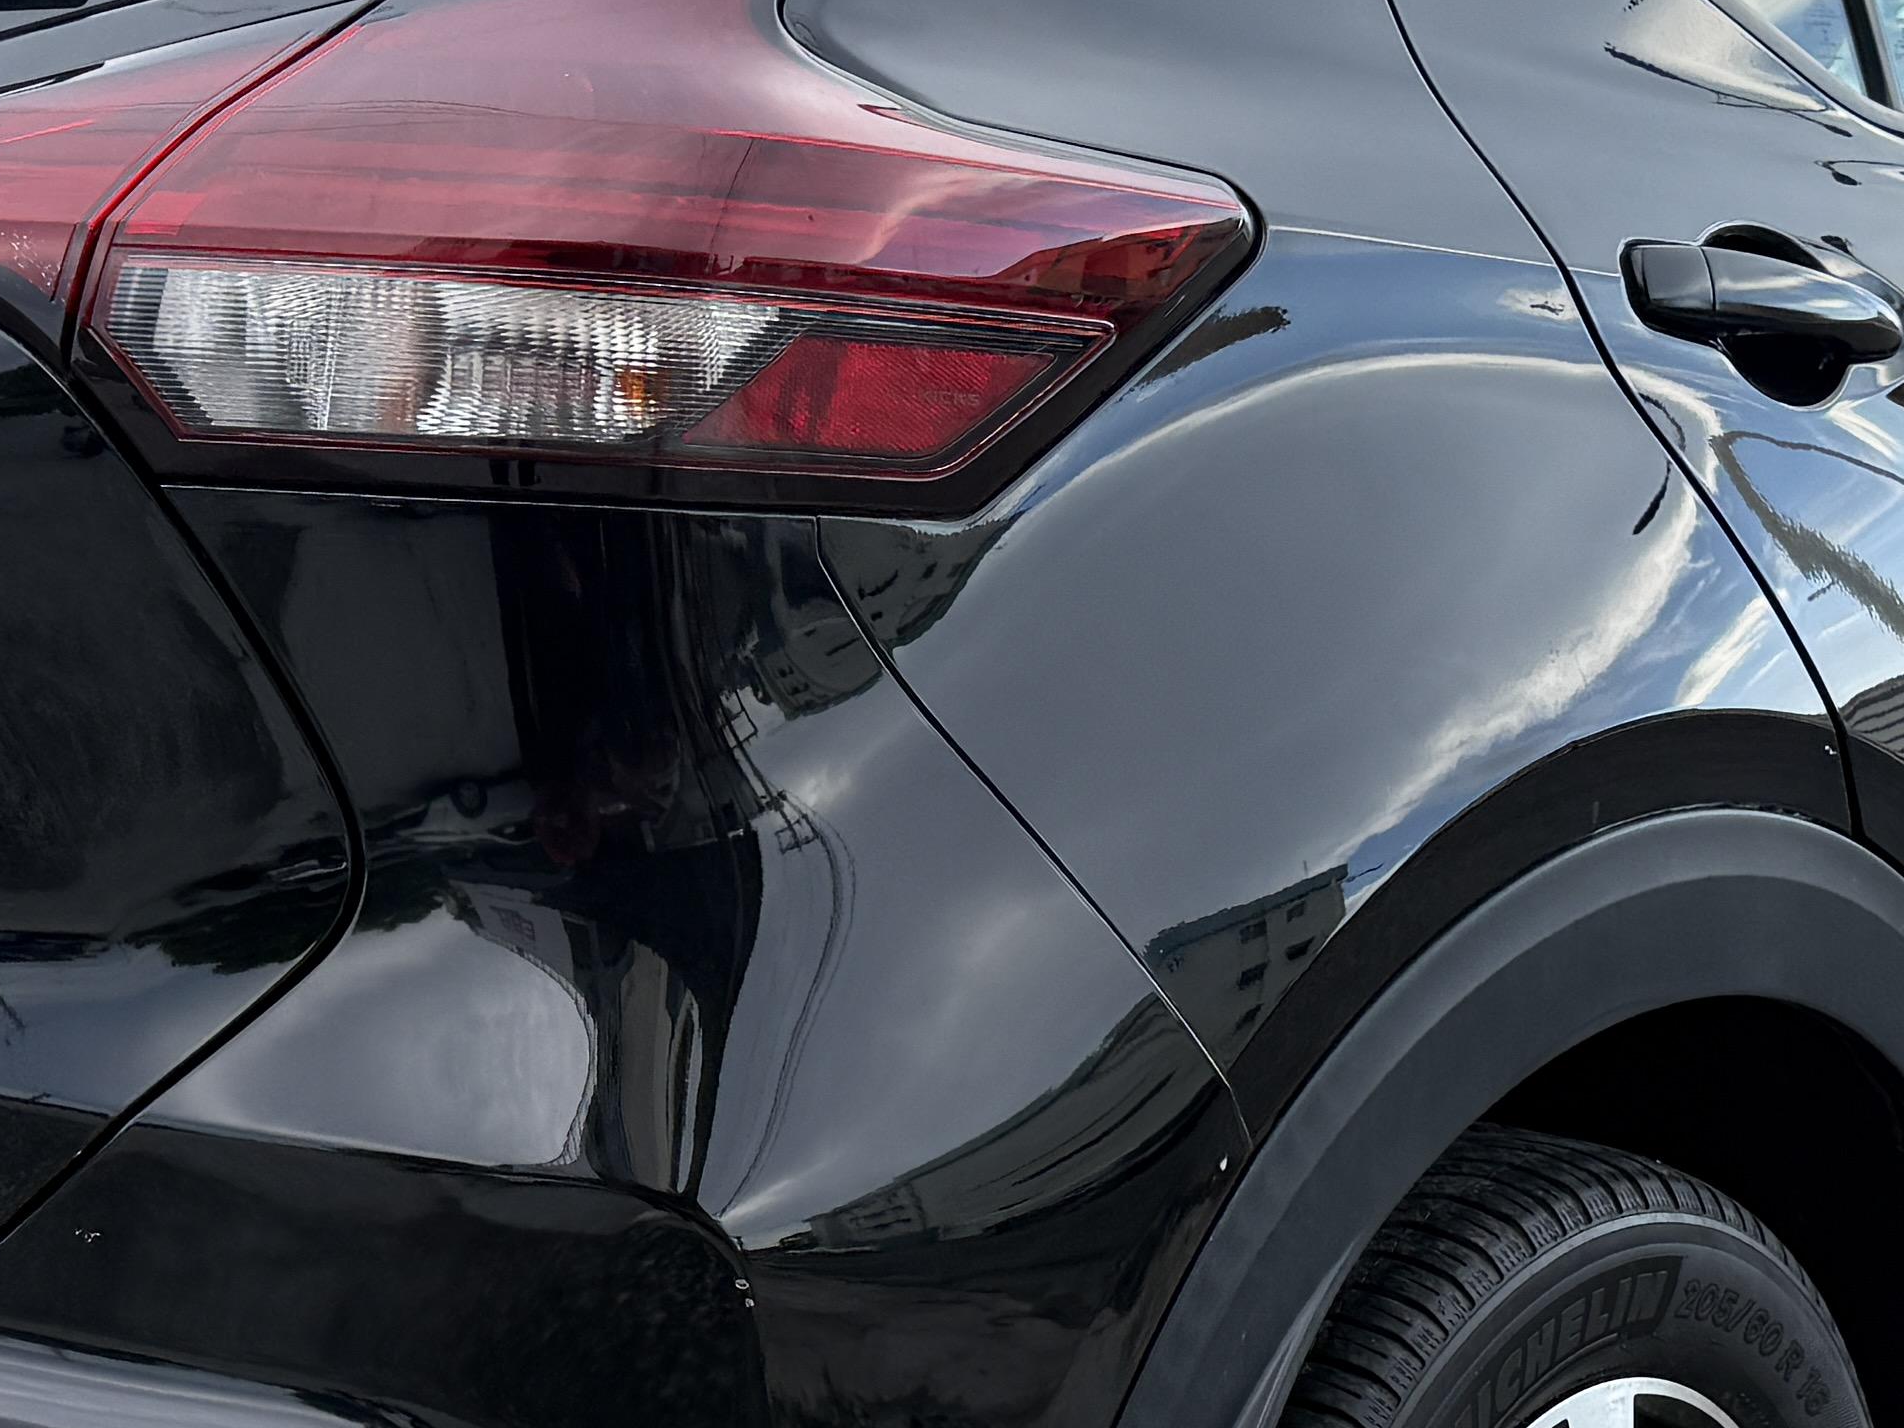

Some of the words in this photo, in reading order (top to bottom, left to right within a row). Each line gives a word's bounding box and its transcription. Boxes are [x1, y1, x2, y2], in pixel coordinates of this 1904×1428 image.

[1673, 1278, 1785, 1357] 205/60
[1774, 1339, 1805, 1383] R
[1796, 1367, 1831, 1418] 16
